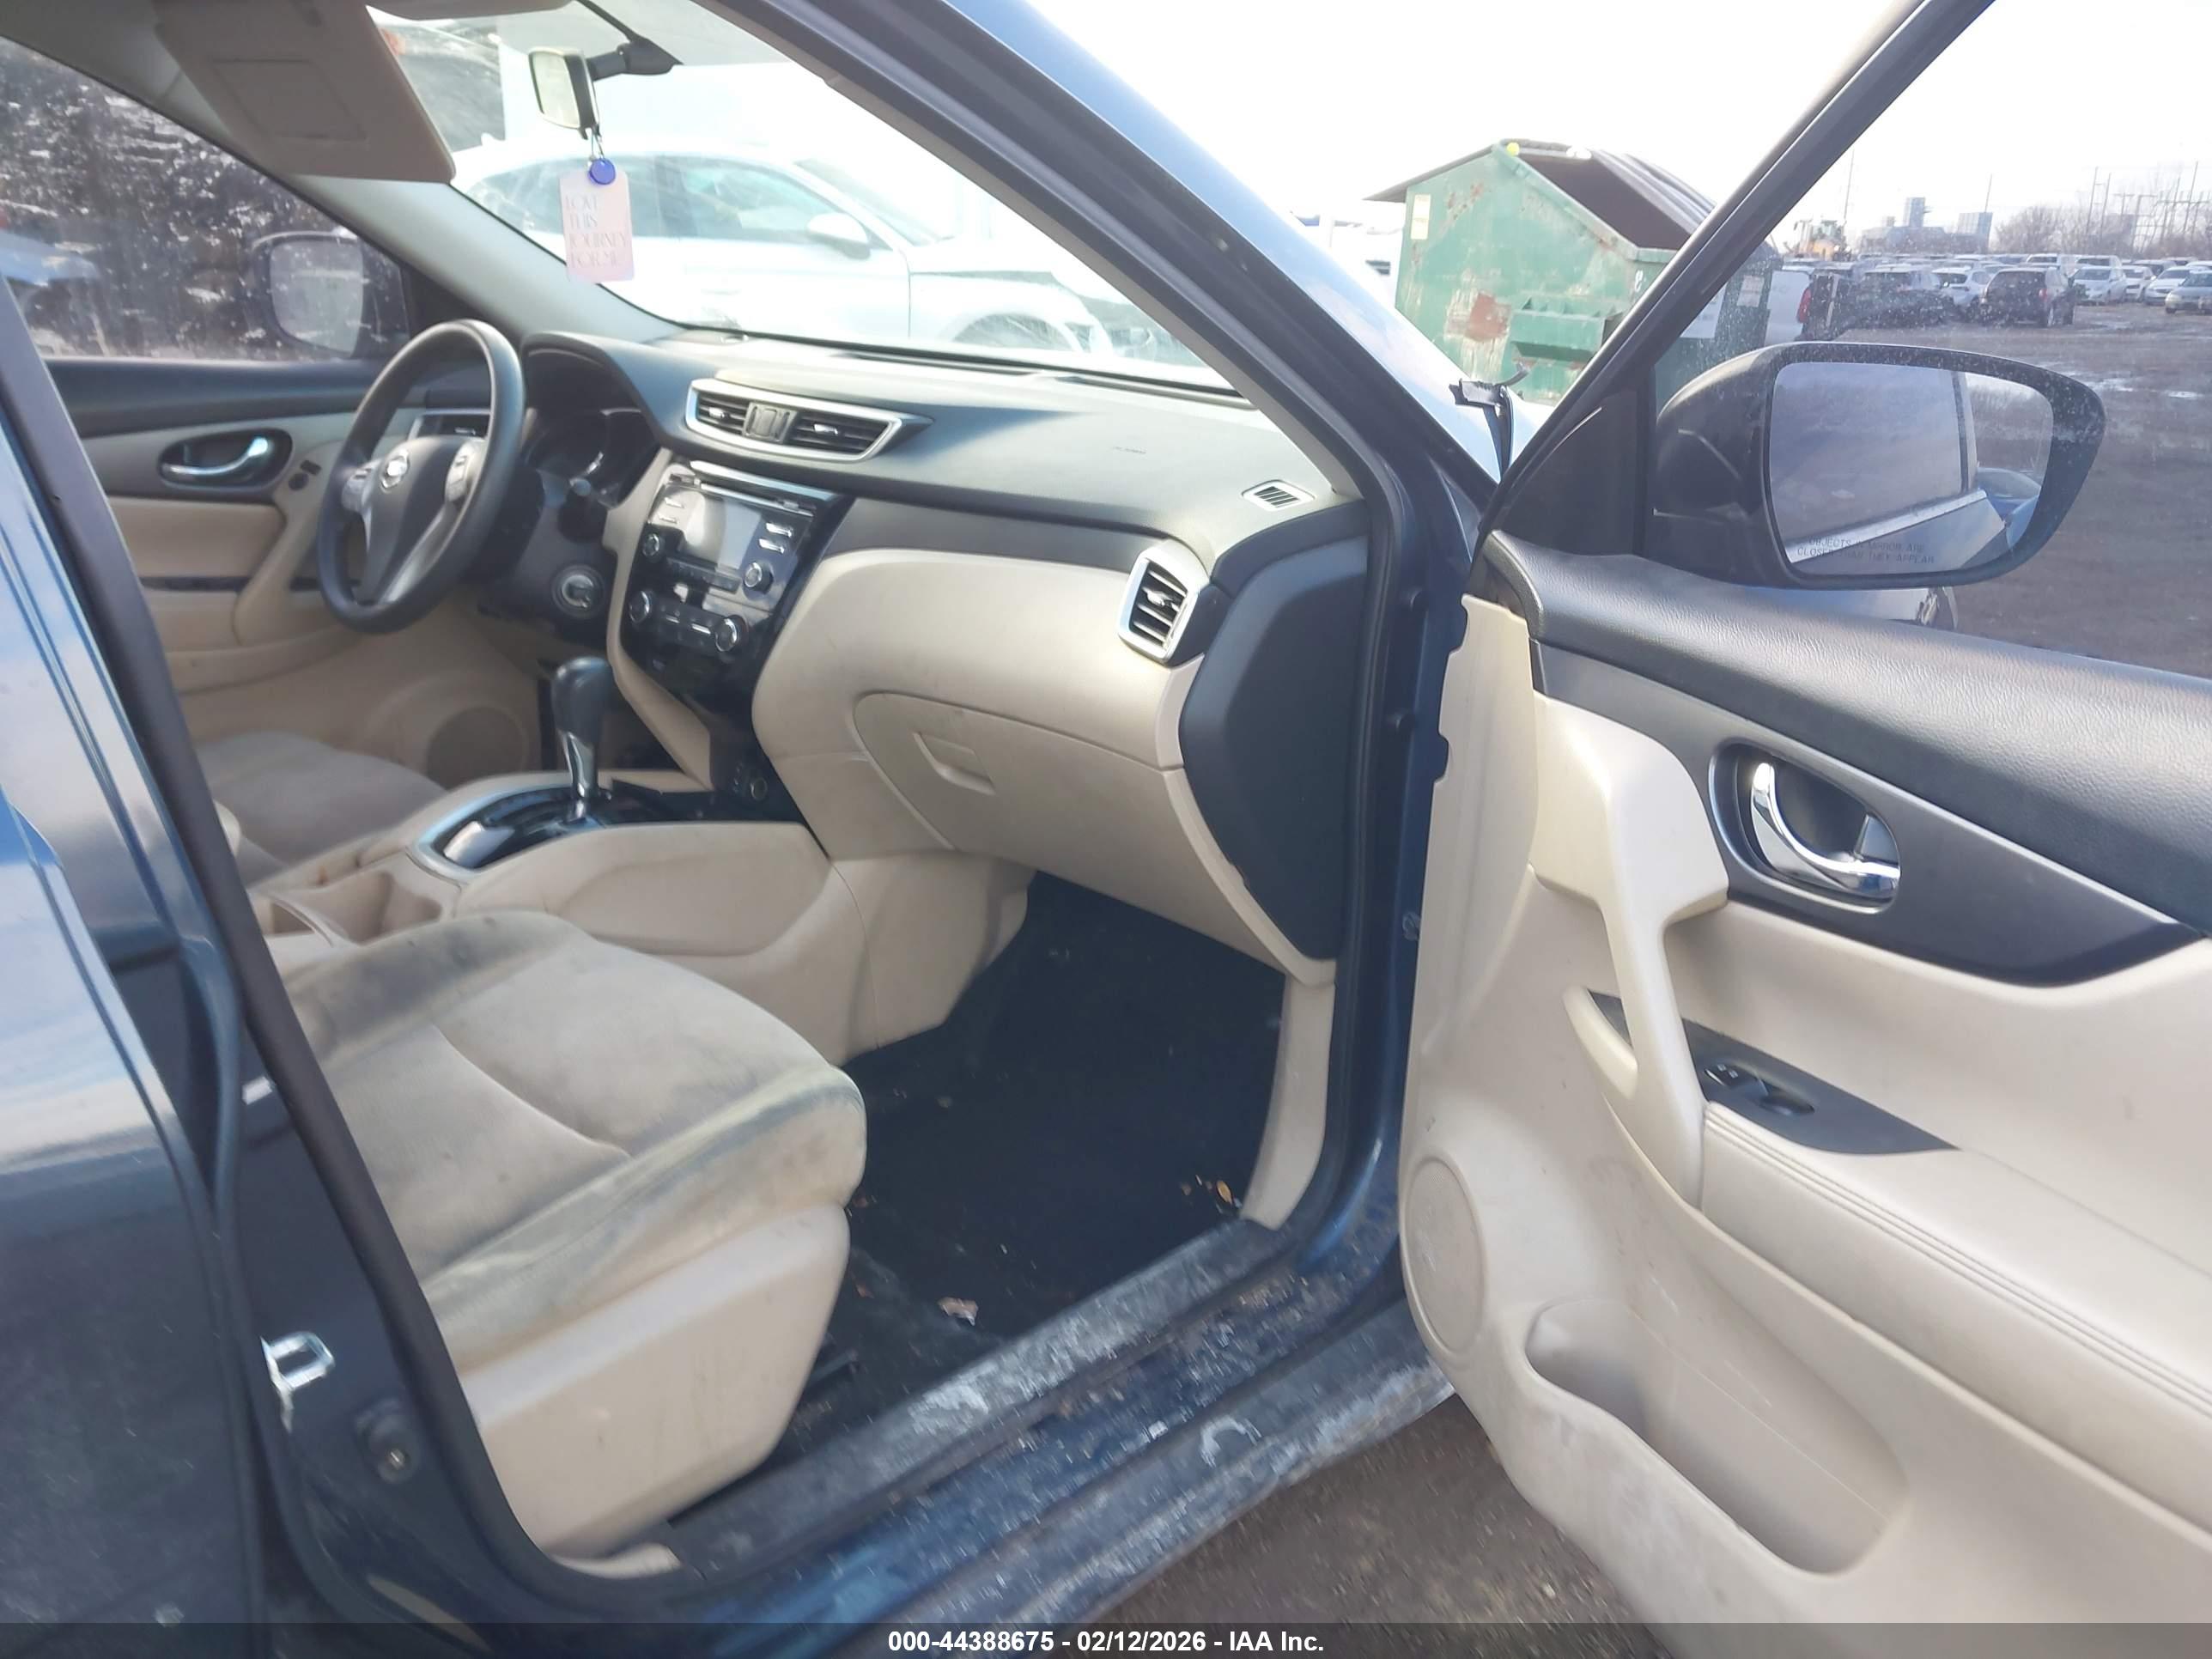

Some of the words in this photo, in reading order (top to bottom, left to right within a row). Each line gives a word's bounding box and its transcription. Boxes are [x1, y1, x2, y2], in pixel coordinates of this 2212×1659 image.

[1808, 536, 1852, 548] OBJECTS
[1797, 547, 1835, 557] CLOSER
[1896, 554, 1935, 564] APPEAR
